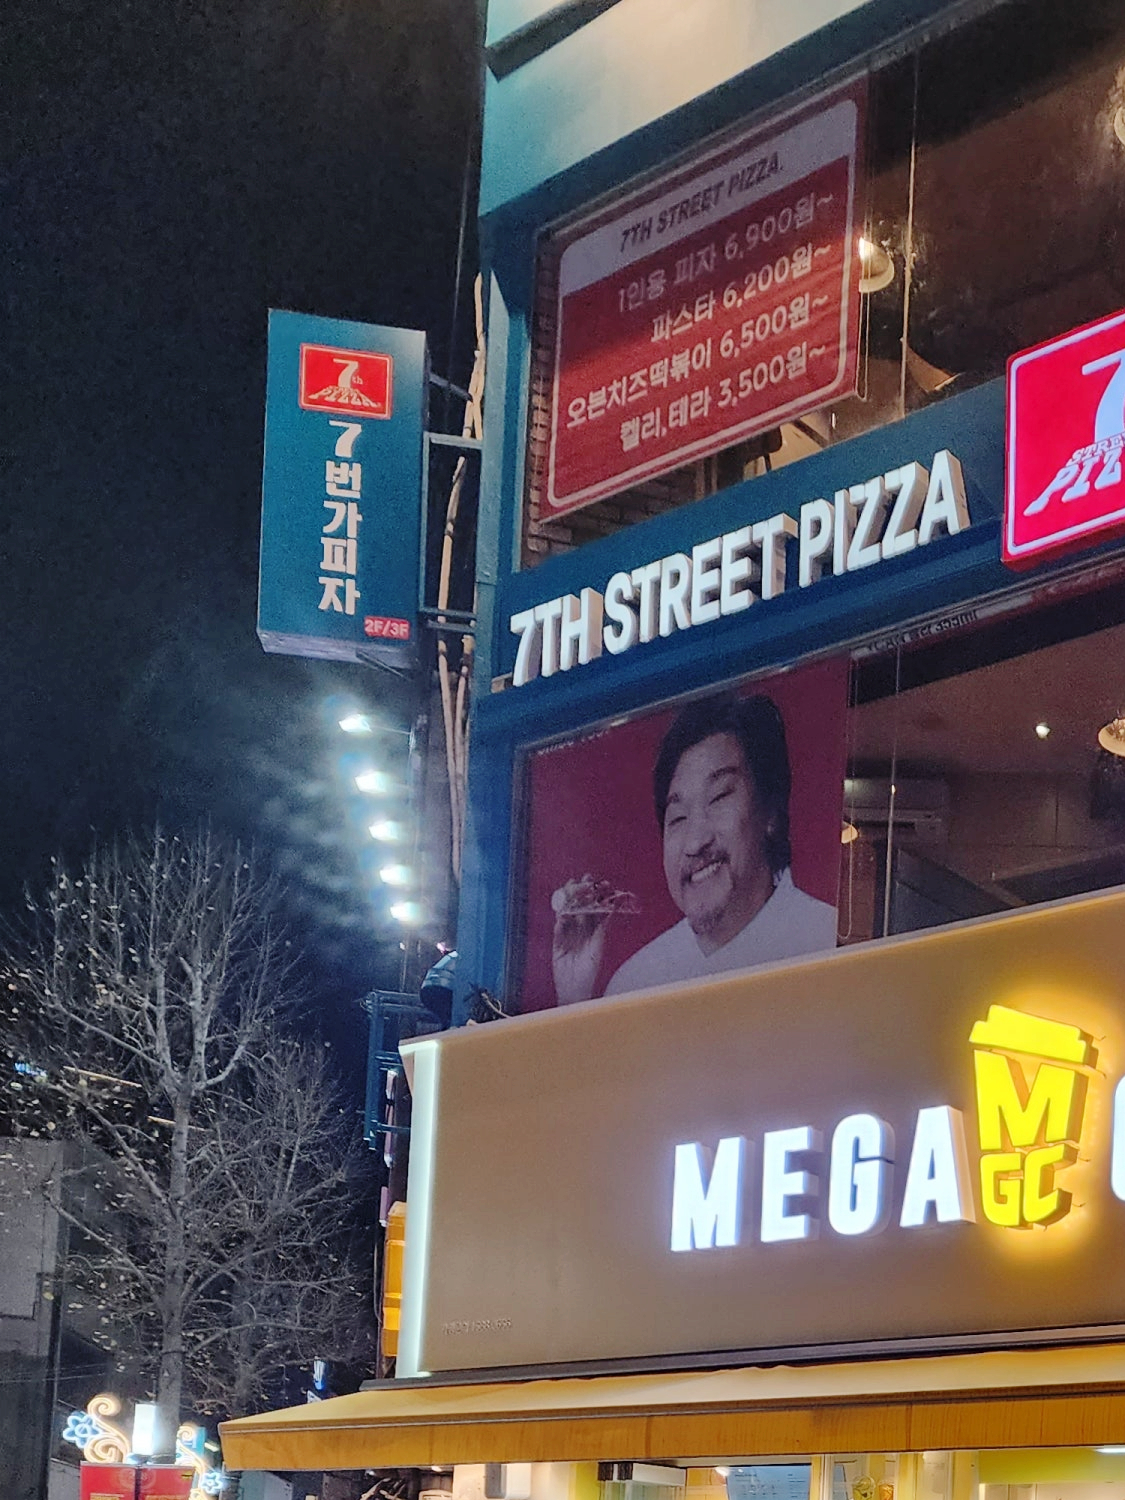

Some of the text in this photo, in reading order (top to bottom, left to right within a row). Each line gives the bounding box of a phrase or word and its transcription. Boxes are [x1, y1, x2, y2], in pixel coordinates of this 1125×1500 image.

[621, 222, 651, 252] 7TH
[656, 182, 724, 235] STREET
[618, 268, 667, 313] 1인용
[674, 244, 718, 286] 피자
[650, 290, 715, 343] 파스타
[566, 338, 713, 430] 오븐치즈떡볶이
[317, 419, 363, 616] 7번가피자
[510, 448, 970, 687] 7TH STREET PIZZA
[364, 617, 410, 638] 2F/3F
[670, 1105, 977, 1252] MEGA
